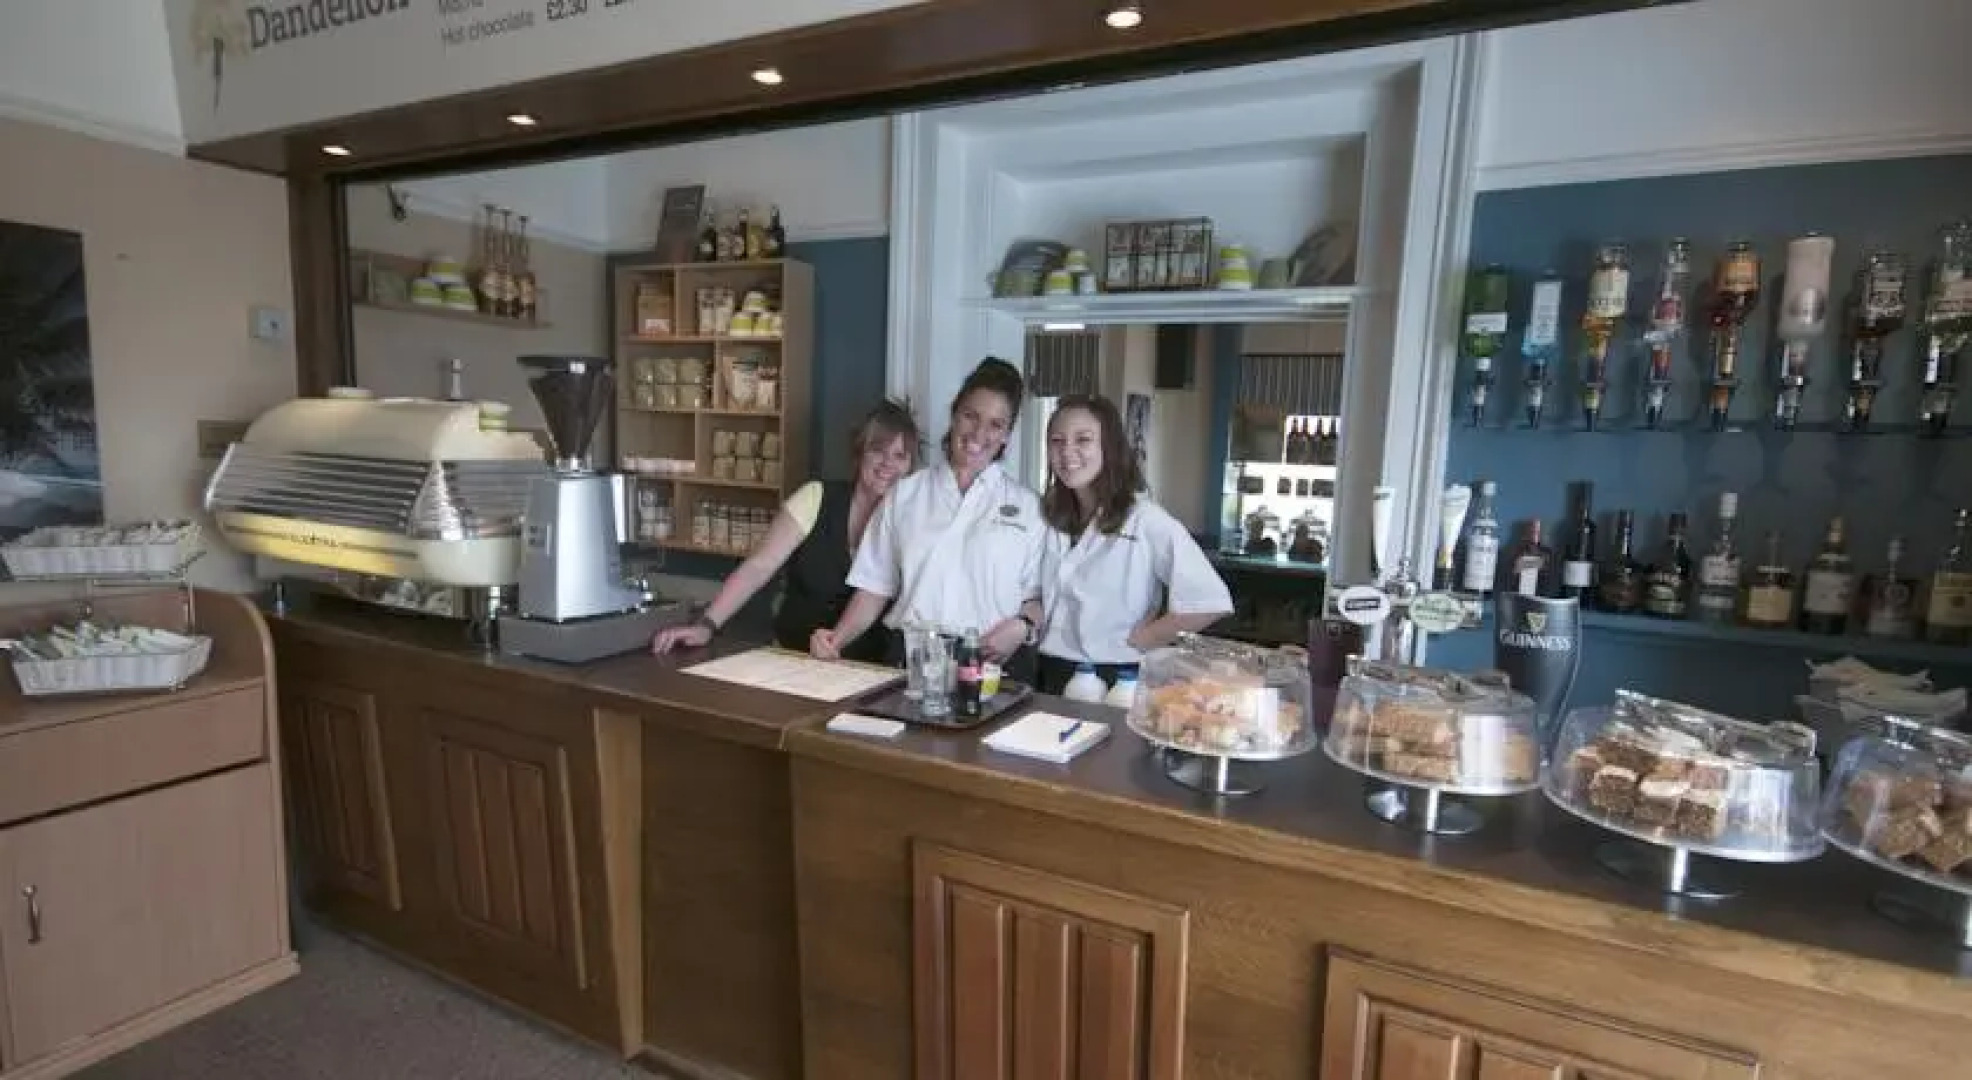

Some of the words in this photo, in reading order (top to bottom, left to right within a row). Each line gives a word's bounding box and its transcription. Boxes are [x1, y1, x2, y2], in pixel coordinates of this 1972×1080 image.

[441, 24, 465, 44] Hot
[469, 8, 535, 41] chocolate
[1500, 628, 1571, 651] GUINNESS
